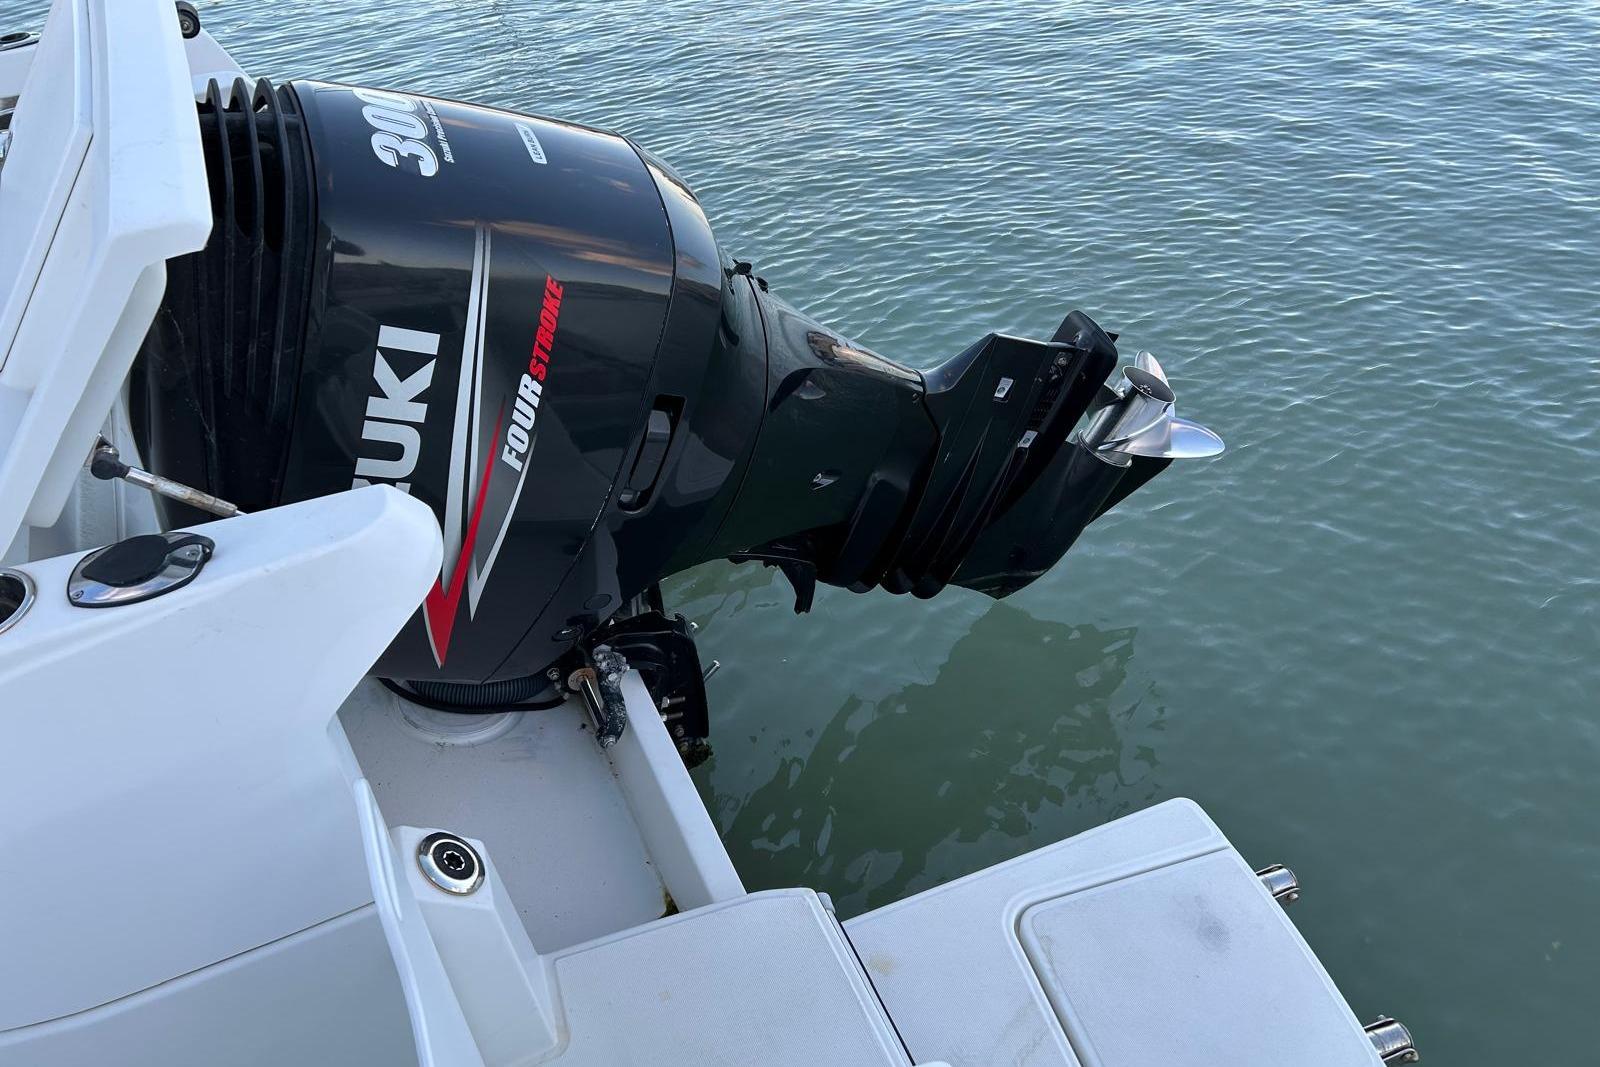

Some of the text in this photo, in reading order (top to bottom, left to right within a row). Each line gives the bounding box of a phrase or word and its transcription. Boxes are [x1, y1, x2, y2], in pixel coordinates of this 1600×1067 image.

[352, 87, 438, 176] 300
[429, 114, 454, 163] Suzuki Precision
[530, 143, 543, 160] LEAN
[351, 324, 441, 494] UKI
